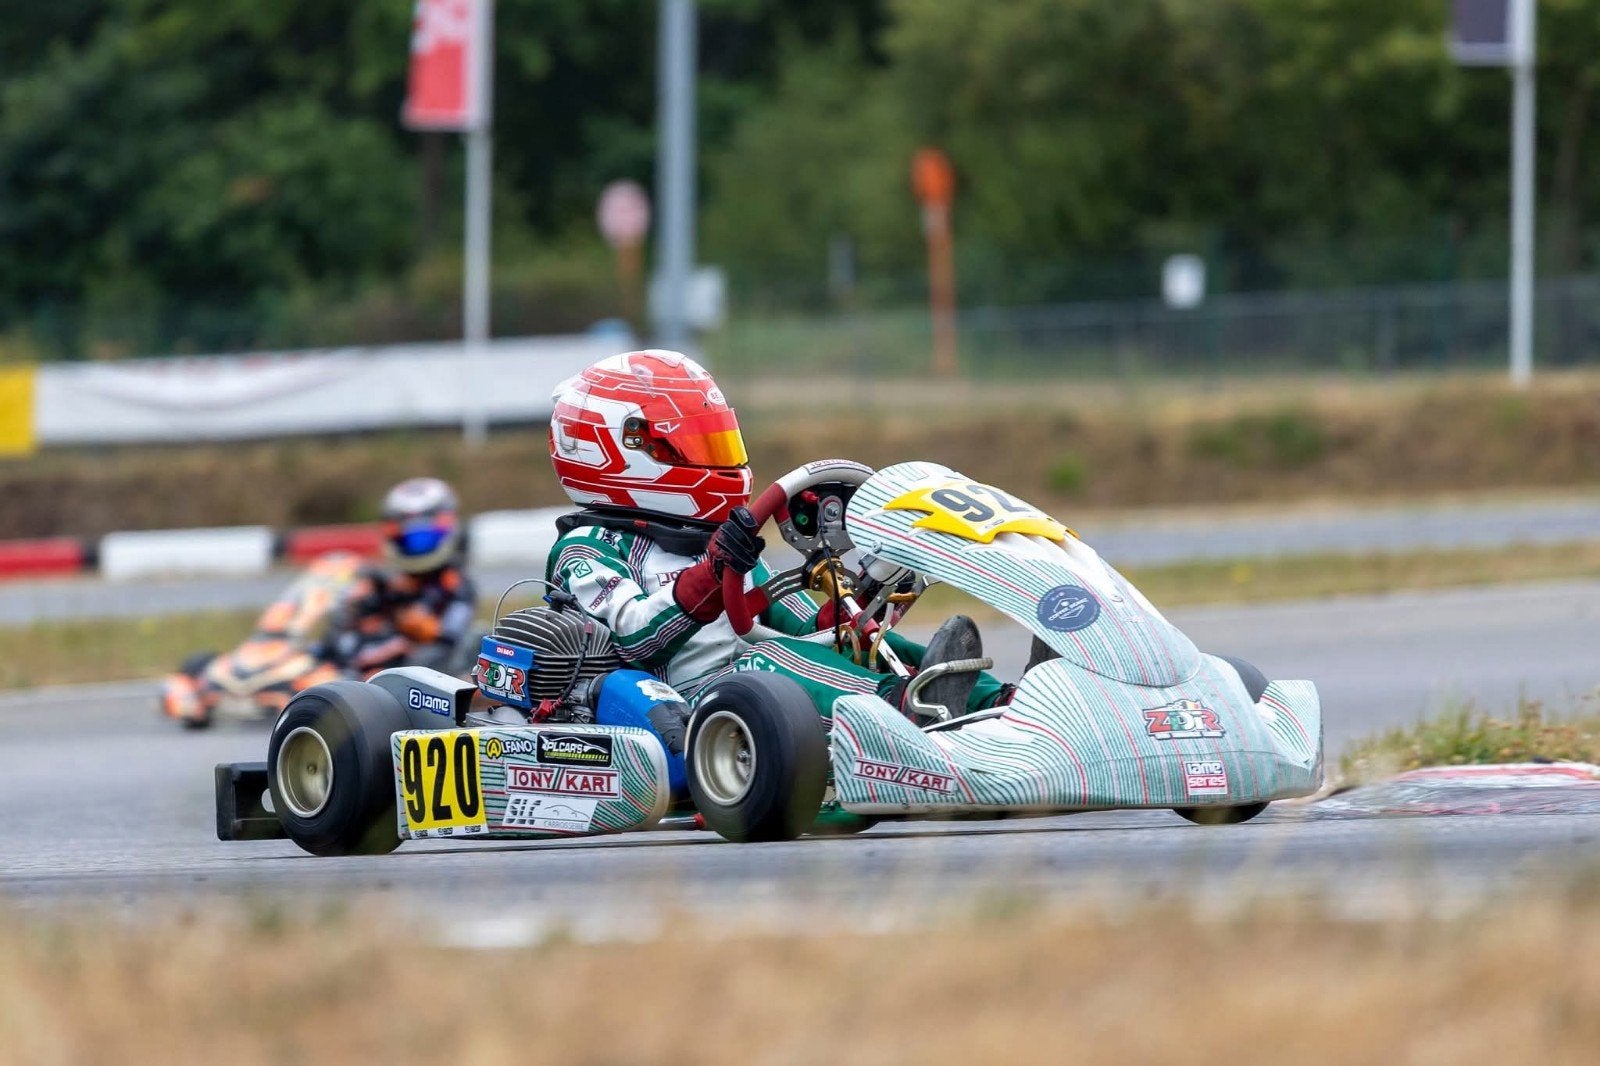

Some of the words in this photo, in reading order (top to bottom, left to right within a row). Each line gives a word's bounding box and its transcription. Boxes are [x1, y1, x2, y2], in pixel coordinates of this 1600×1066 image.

[402, 733, 480, 823] 920
[509, 767, 554, 788] TONY
[566, 771, 617, 792] KART
[856, 760, 899, 780] TONY
[908, 770, 953, 790] KART
